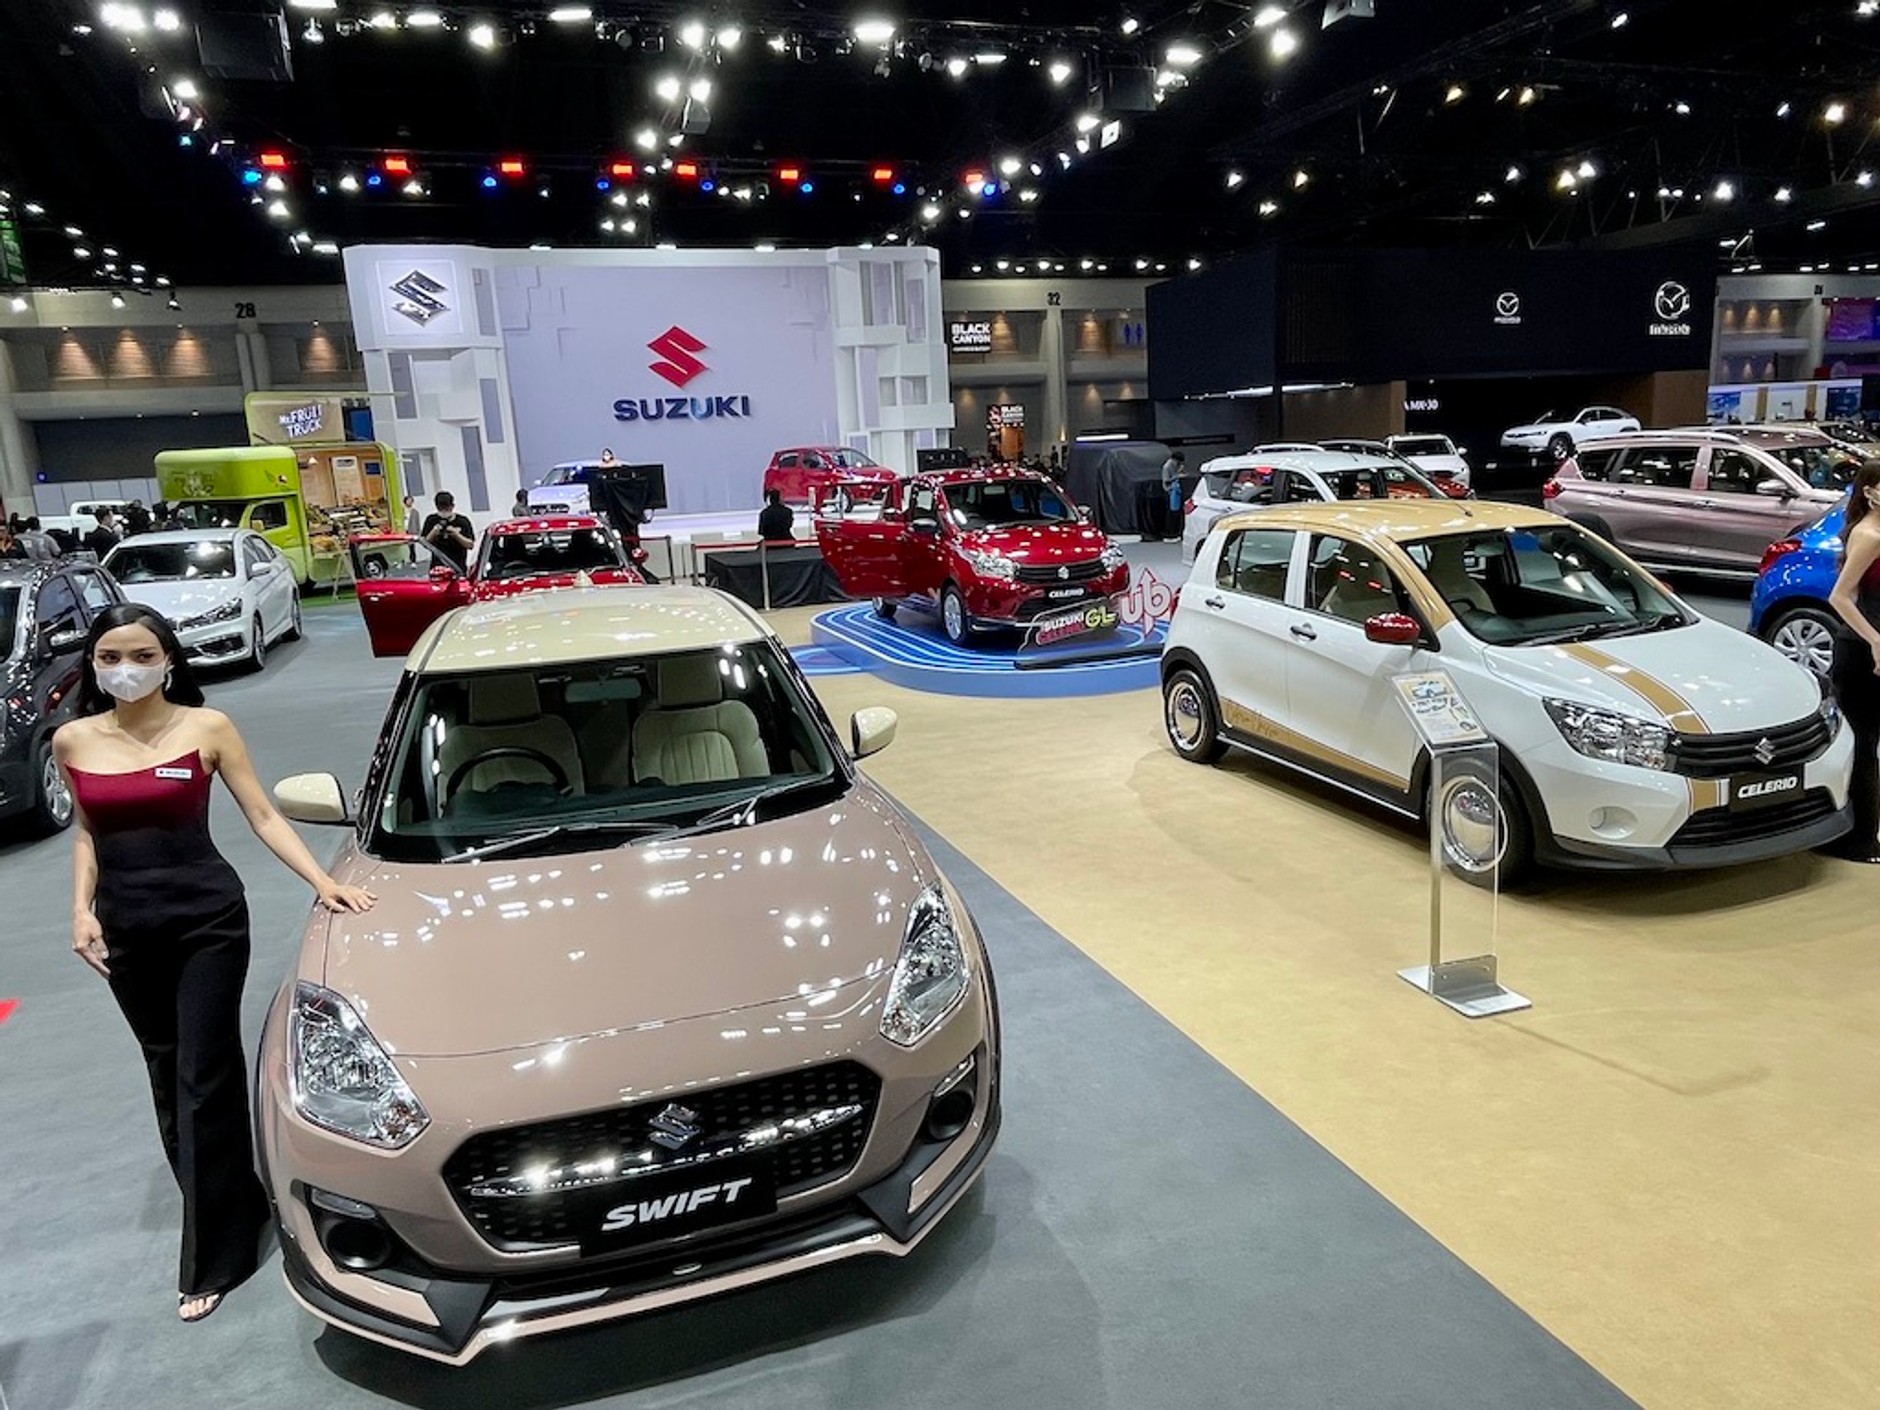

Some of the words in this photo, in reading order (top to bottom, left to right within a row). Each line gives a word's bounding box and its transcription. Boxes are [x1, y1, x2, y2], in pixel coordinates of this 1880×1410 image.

[1046, 291, 1061, 306] 32
[235, 302, 256, 319] 28
[951, 322, 991, 335] BLACK
[951, 334, 991, 344] CANYON
[612, 395, 751, 421] SUZUKI
[286, 418, 323, 437] TRUCK
[1042, 611, 1085, 632] SUZUKI
[1737, 775, 1798, 799] CELERIO
[601, 1177, 752, 1231] SWIFT
